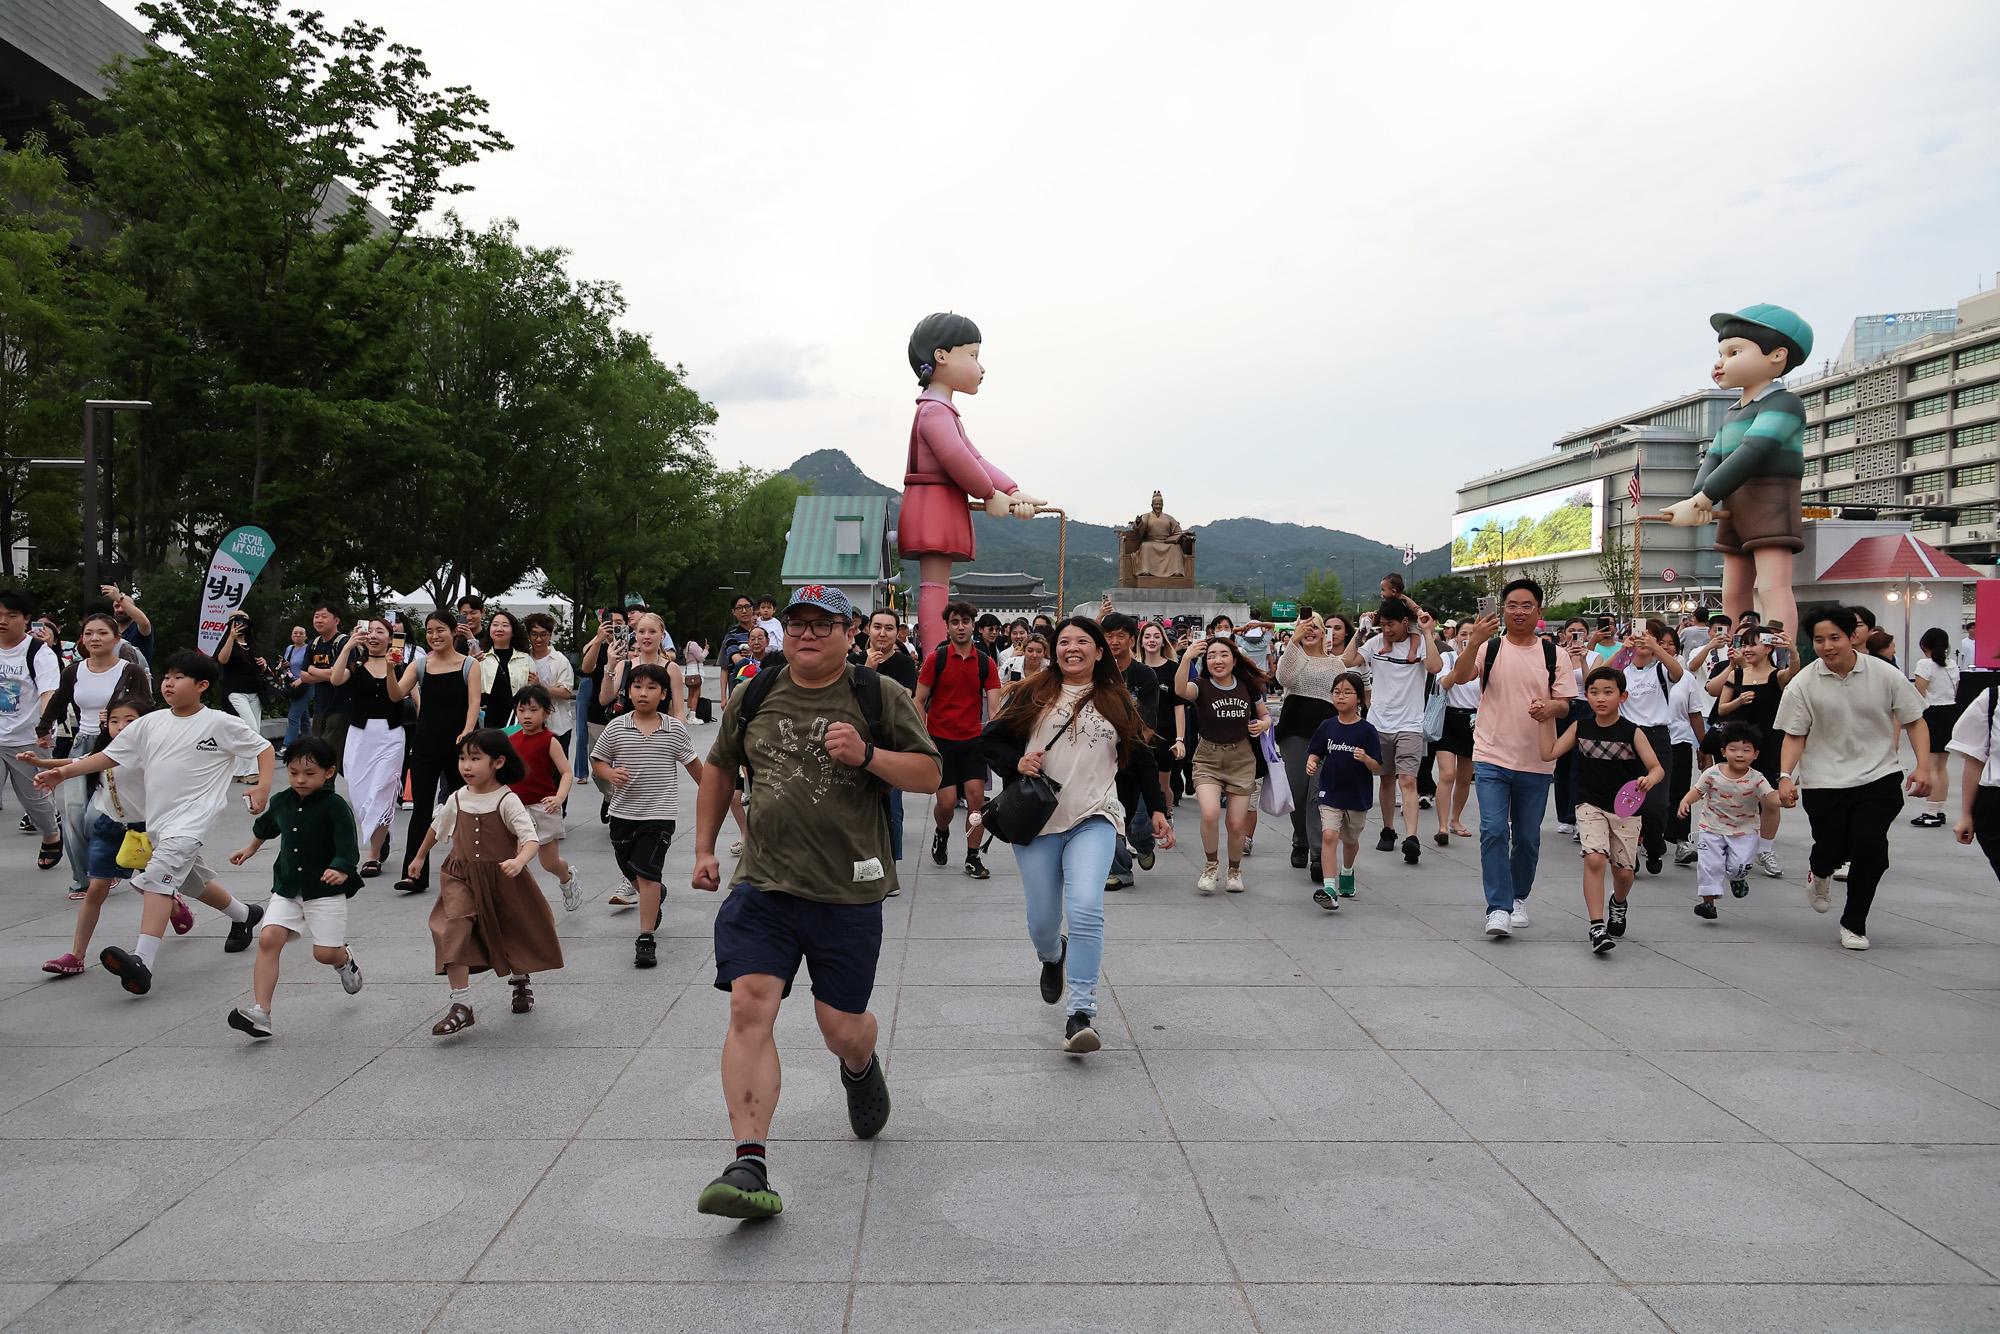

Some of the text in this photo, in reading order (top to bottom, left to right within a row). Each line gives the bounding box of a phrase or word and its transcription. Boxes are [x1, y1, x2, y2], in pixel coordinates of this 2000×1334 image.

[1897, 312, 1934, 324] 우리카드
[245, 544, 266, 558] SOUL
[231, 567, 255, 576] FESTIVAL
[200, 620, 227, 632] OPEN
[1211, 697, 1249, 710] ATHLETICS
[1216, 709, 1246, 718] LEAGUE
[1327, 738, 1356, 754] Yankee
